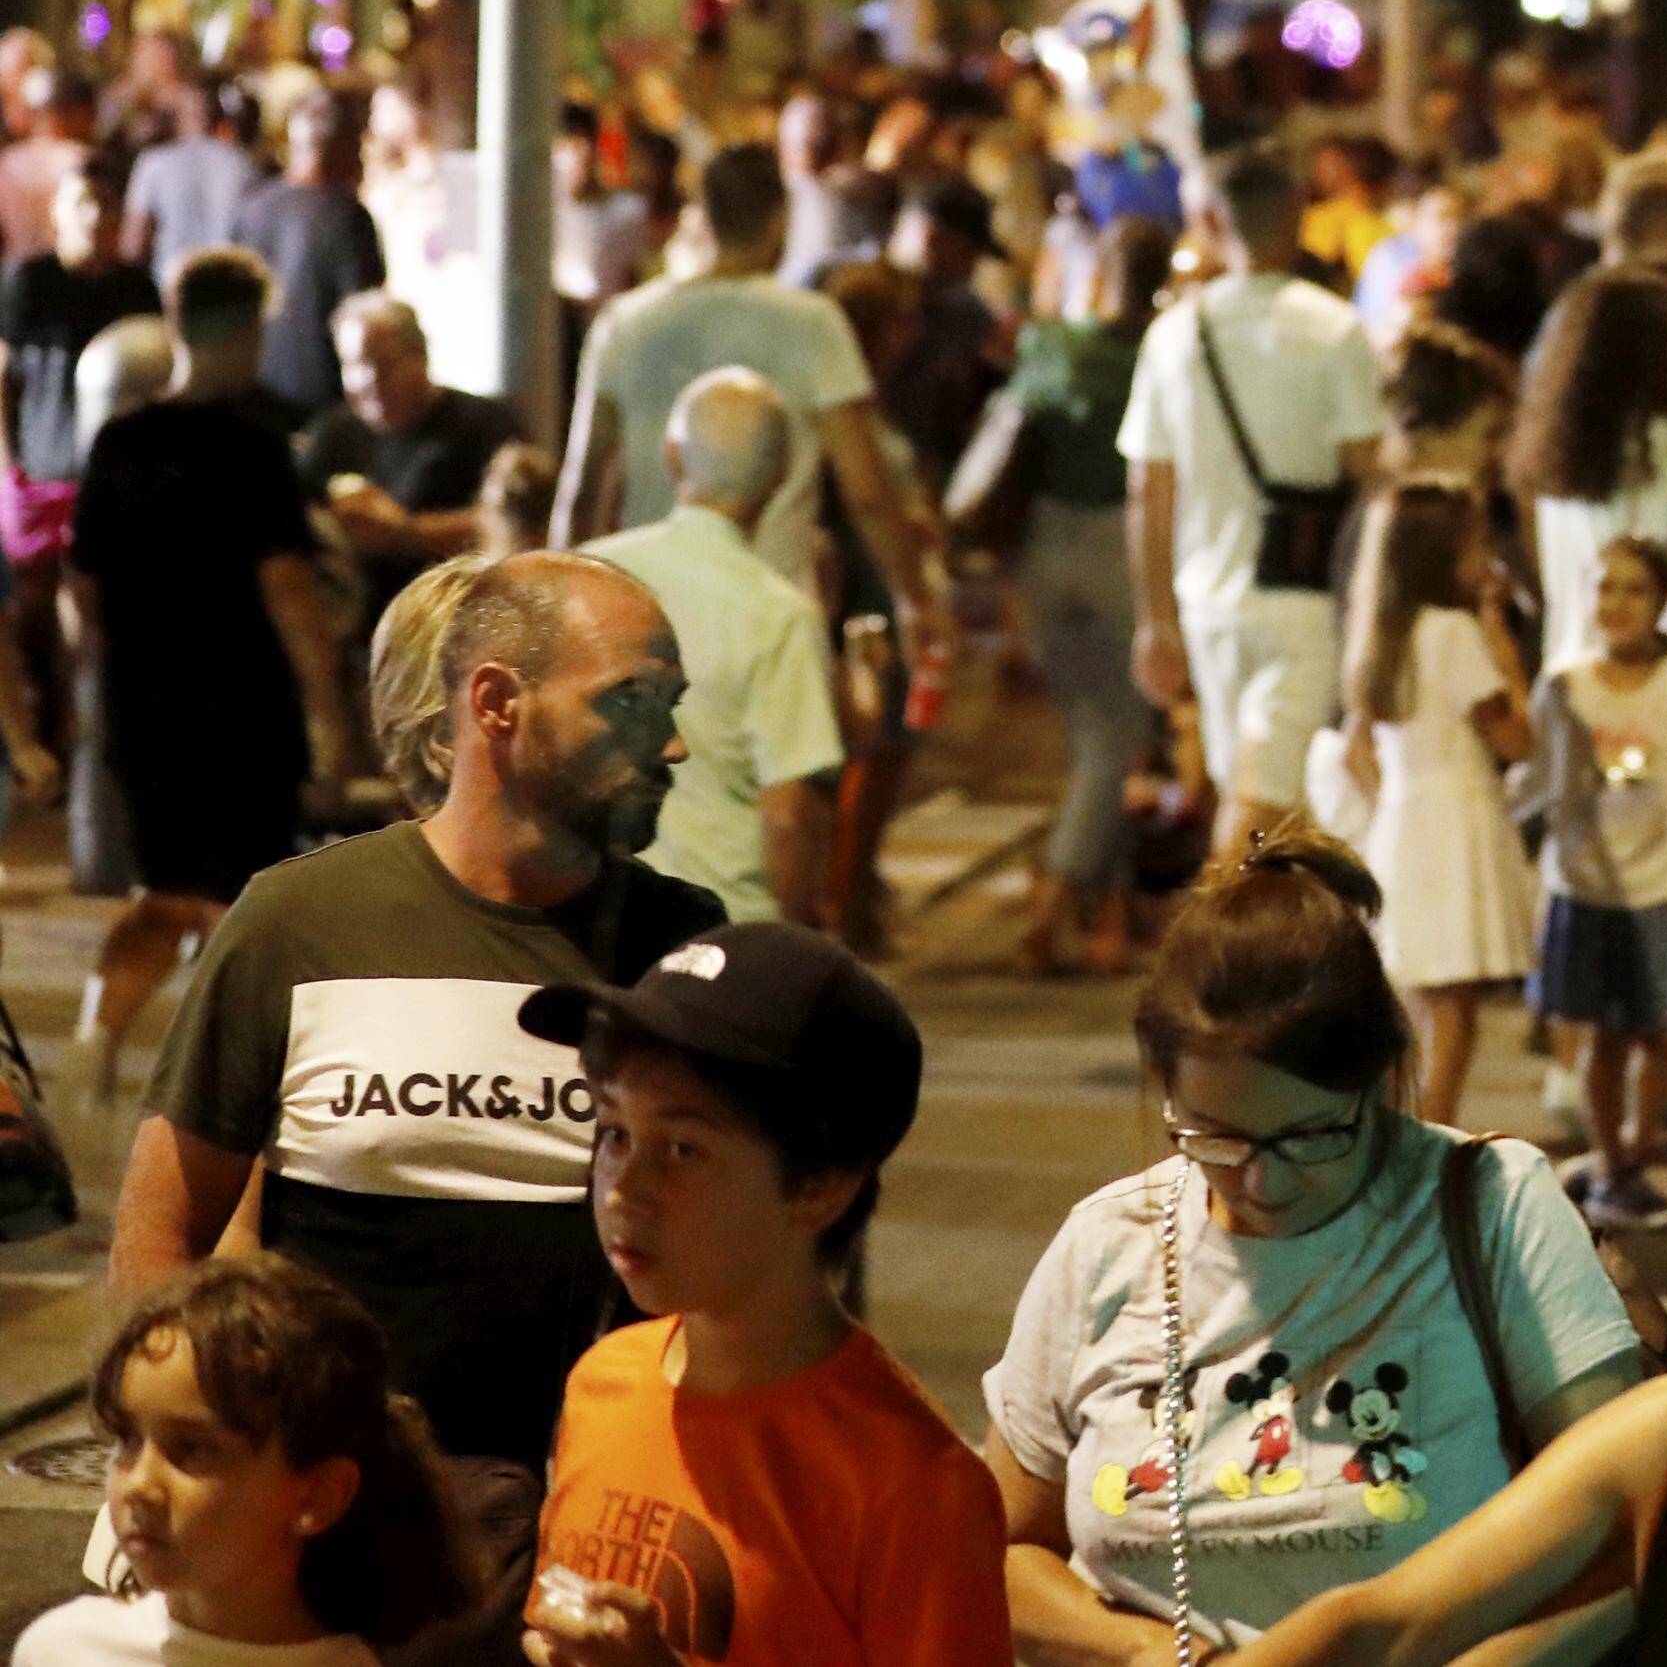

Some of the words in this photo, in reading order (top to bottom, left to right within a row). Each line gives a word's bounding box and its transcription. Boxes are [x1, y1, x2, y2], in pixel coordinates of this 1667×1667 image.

[597, 1489, 675, 1546] THE
[1253, 1525, 1385, 1555] MOUSE
[544, 1529, 660, 1594] ORTH
